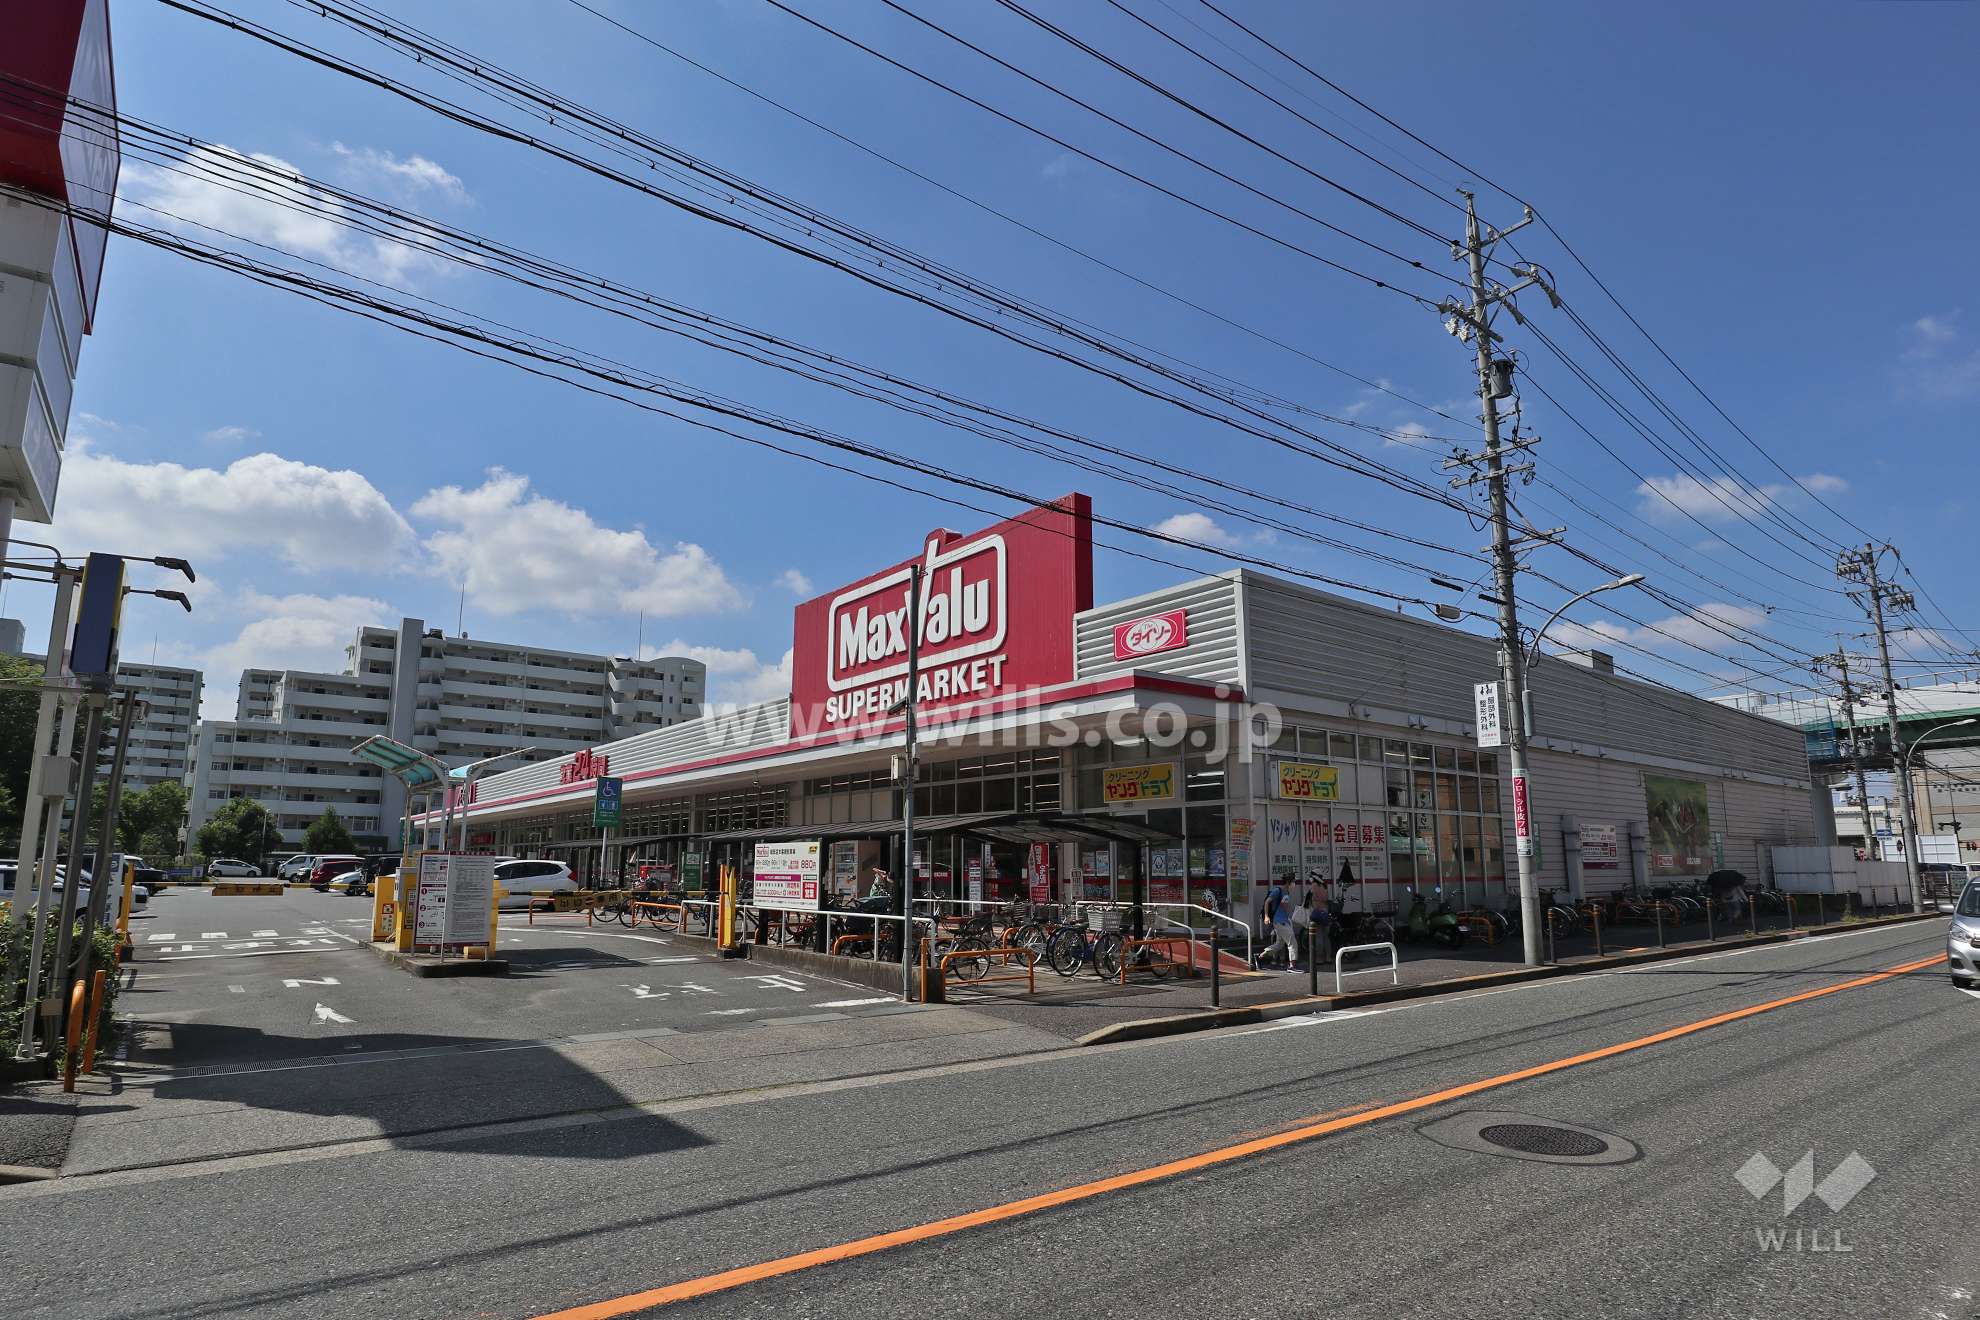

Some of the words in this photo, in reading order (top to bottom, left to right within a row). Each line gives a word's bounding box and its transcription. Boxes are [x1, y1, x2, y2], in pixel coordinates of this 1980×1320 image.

[839, 539, 989, 670] MaxValu
[825, 654, 1008, 723] SUPERMARKET
[1106, 769, 1172, 798] ヤングドライ
[1108, 769, 1151, 782] クリーニング
[1283, 767, 1320, 779] クリーニング
[1281, 774, 1337, 797] ヤングドライ
[1270, 818, 1298, 844] Yシャツ
[1303, 820, 1329, 844] 100円
[1334, 823, 1384, 844] 会員募集
